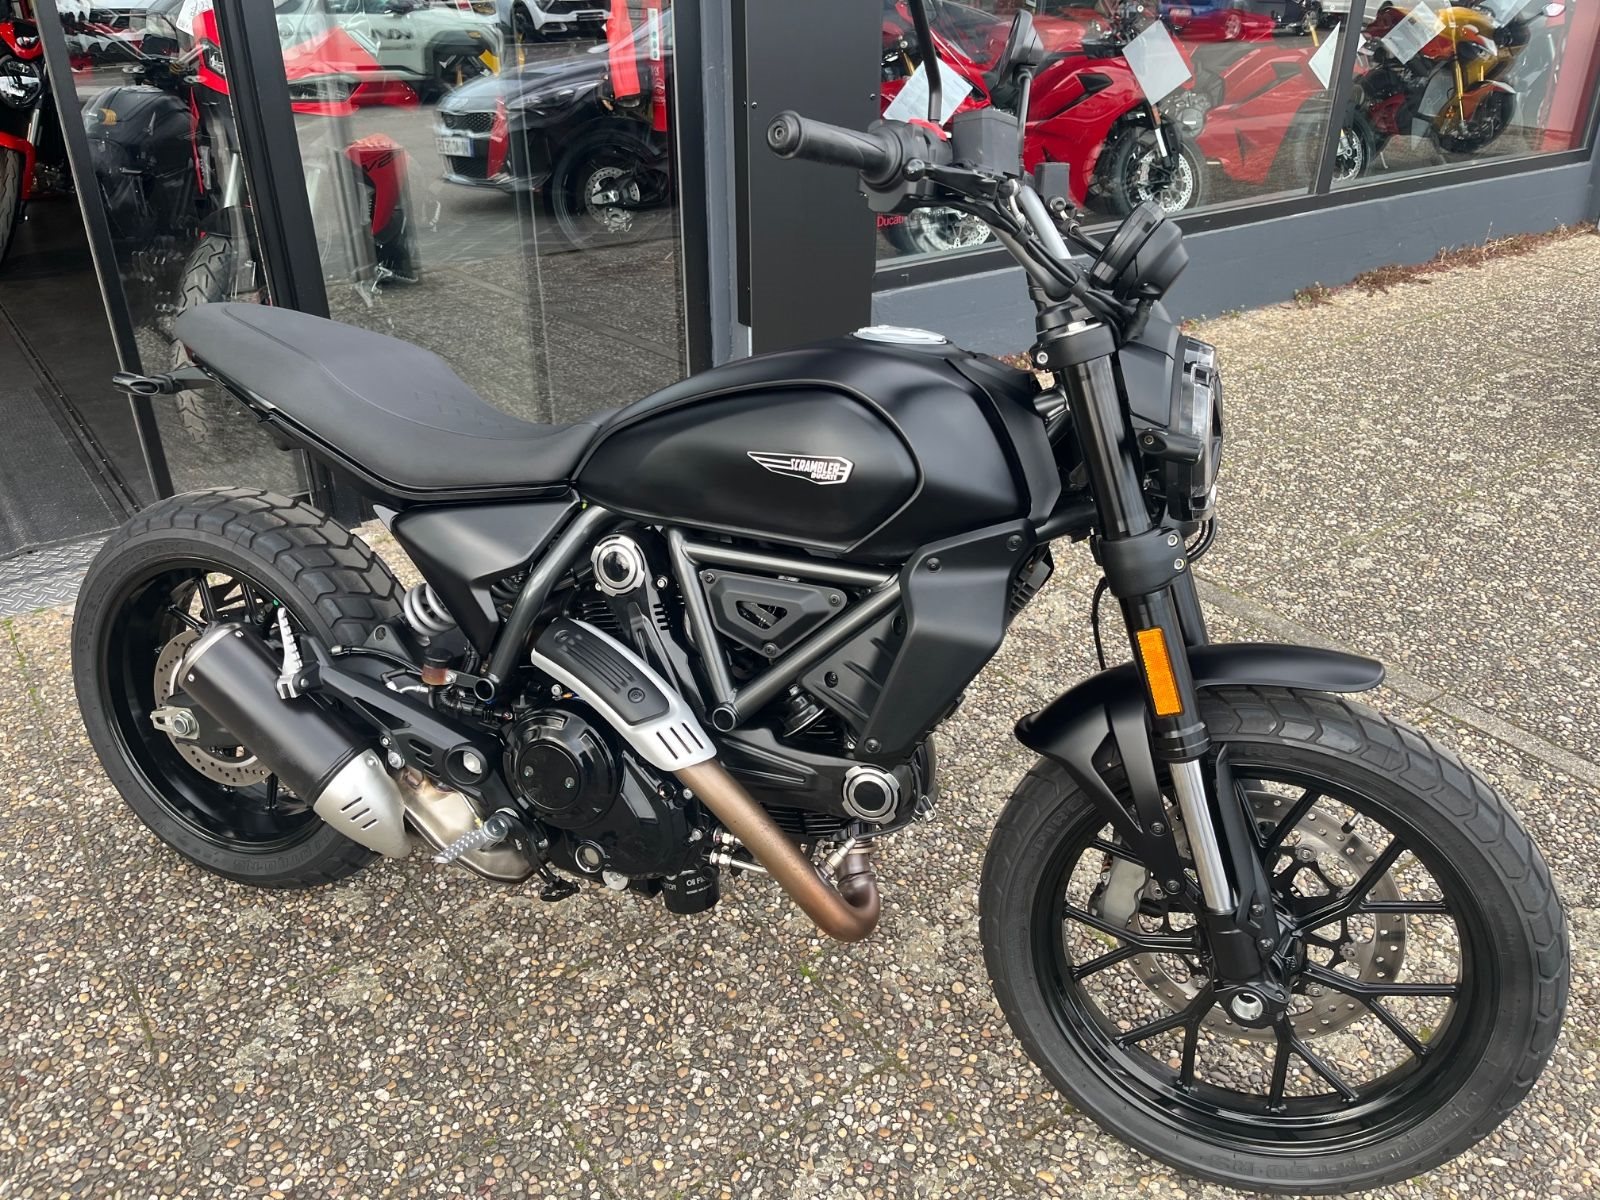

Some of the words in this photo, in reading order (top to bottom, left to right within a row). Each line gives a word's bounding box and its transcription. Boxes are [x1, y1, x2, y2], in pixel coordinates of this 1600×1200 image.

[877, 214, 906, 228] Ducati
[790, 458, 840, 475] SCRAMBLER
[811, 471, 837, 481] DUCATI
